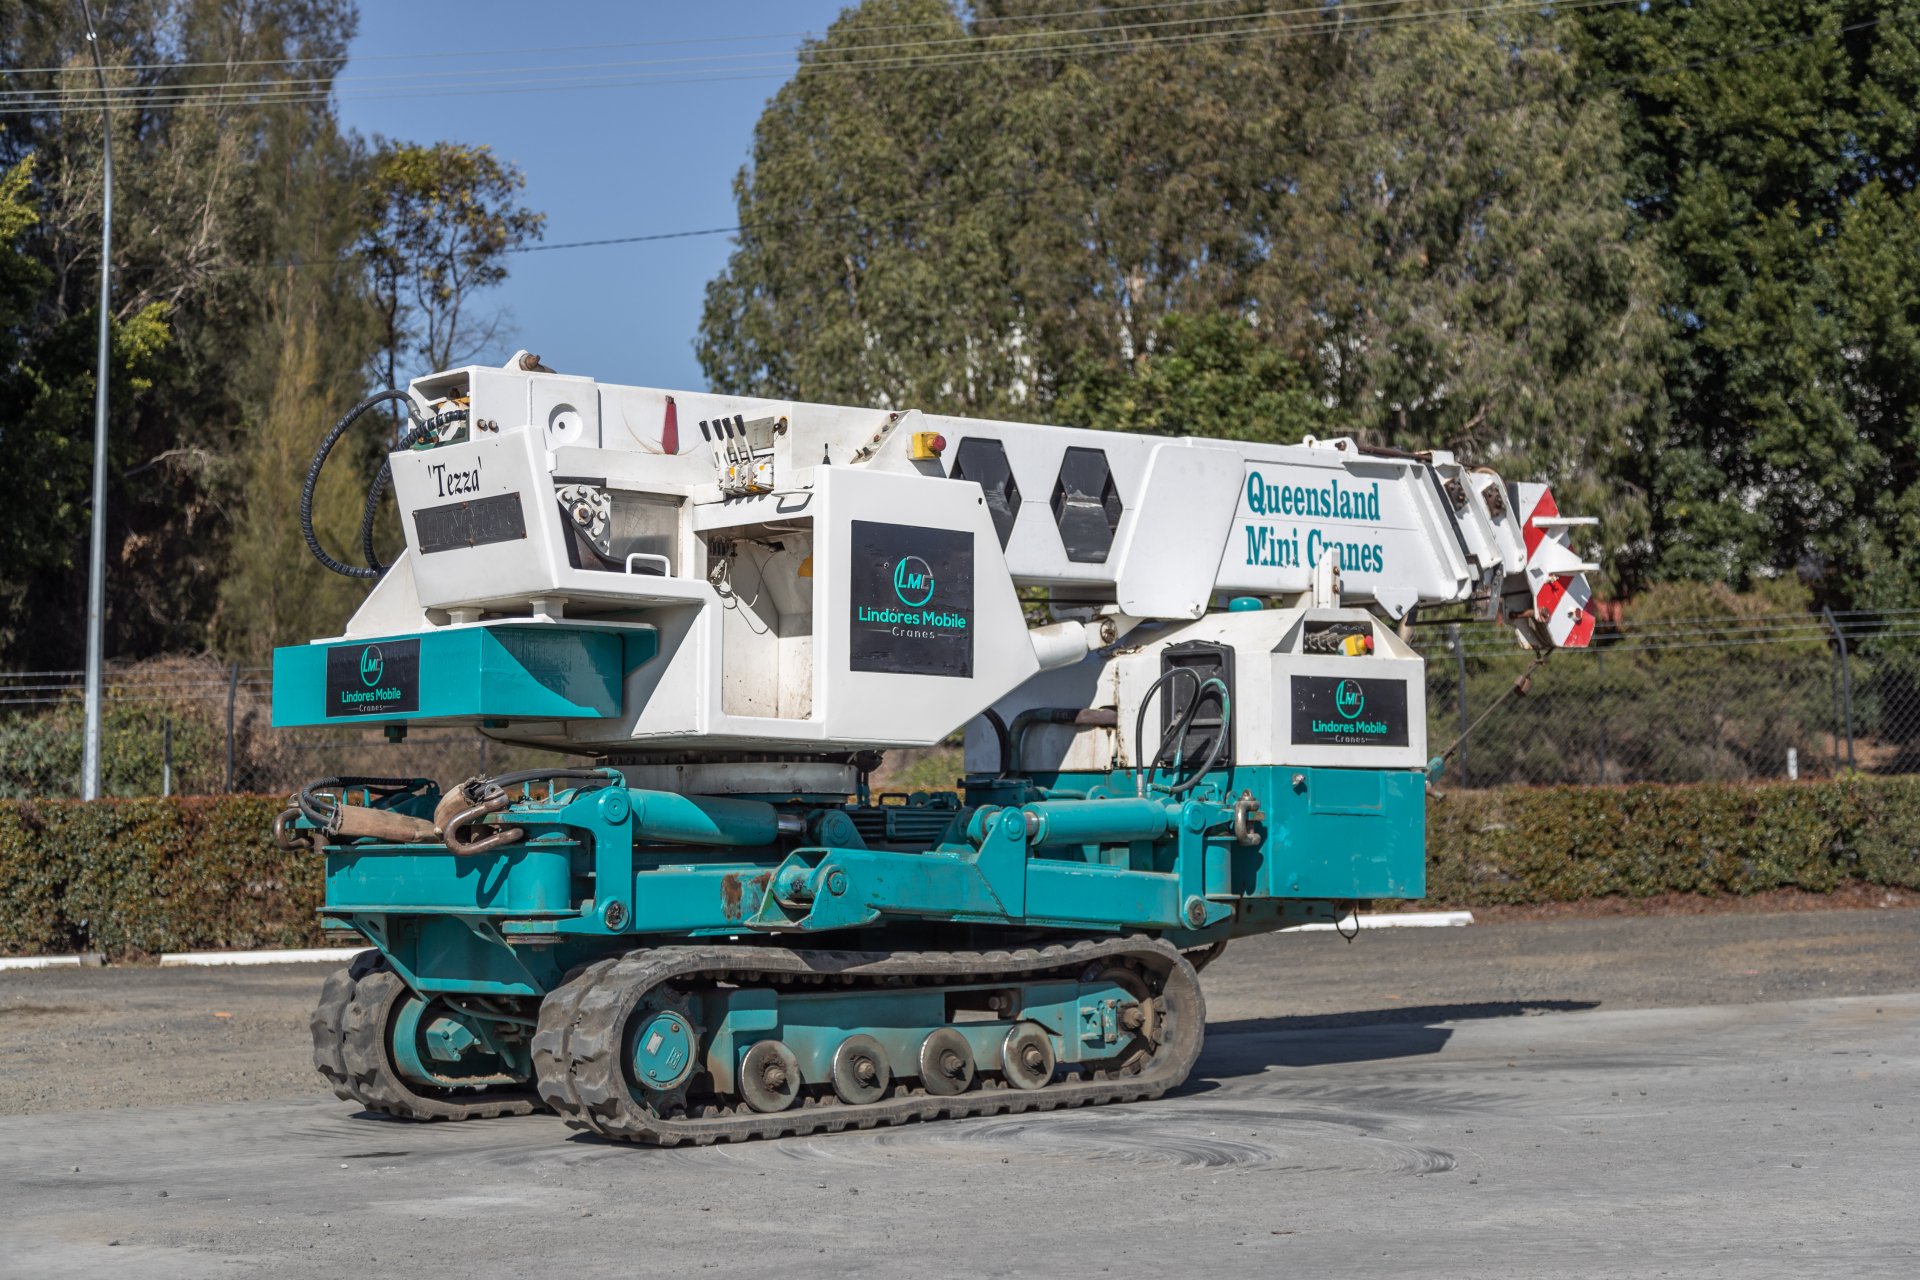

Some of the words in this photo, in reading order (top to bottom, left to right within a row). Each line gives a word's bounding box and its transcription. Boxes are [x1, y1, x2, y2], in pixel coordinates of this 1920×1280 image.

[1247, 471, 1381, 521] Queensland
[1245, 525, 1300, 568] Mini
[858, 606, 920, 625] Lindores
[922, 611, 967, 628] Mobile
[891, 626, 936, 639] Cranes
[341, 688, 375, 703] Lindores
[375, 687, 401, 701] Mobile
[358, 704, 384, 712] Cranes
[1312, 719, 1355, 734] Lindores
[1355, 720, 1388, 734] Mobile
[1334, 734, 1366, 744] Cranes
